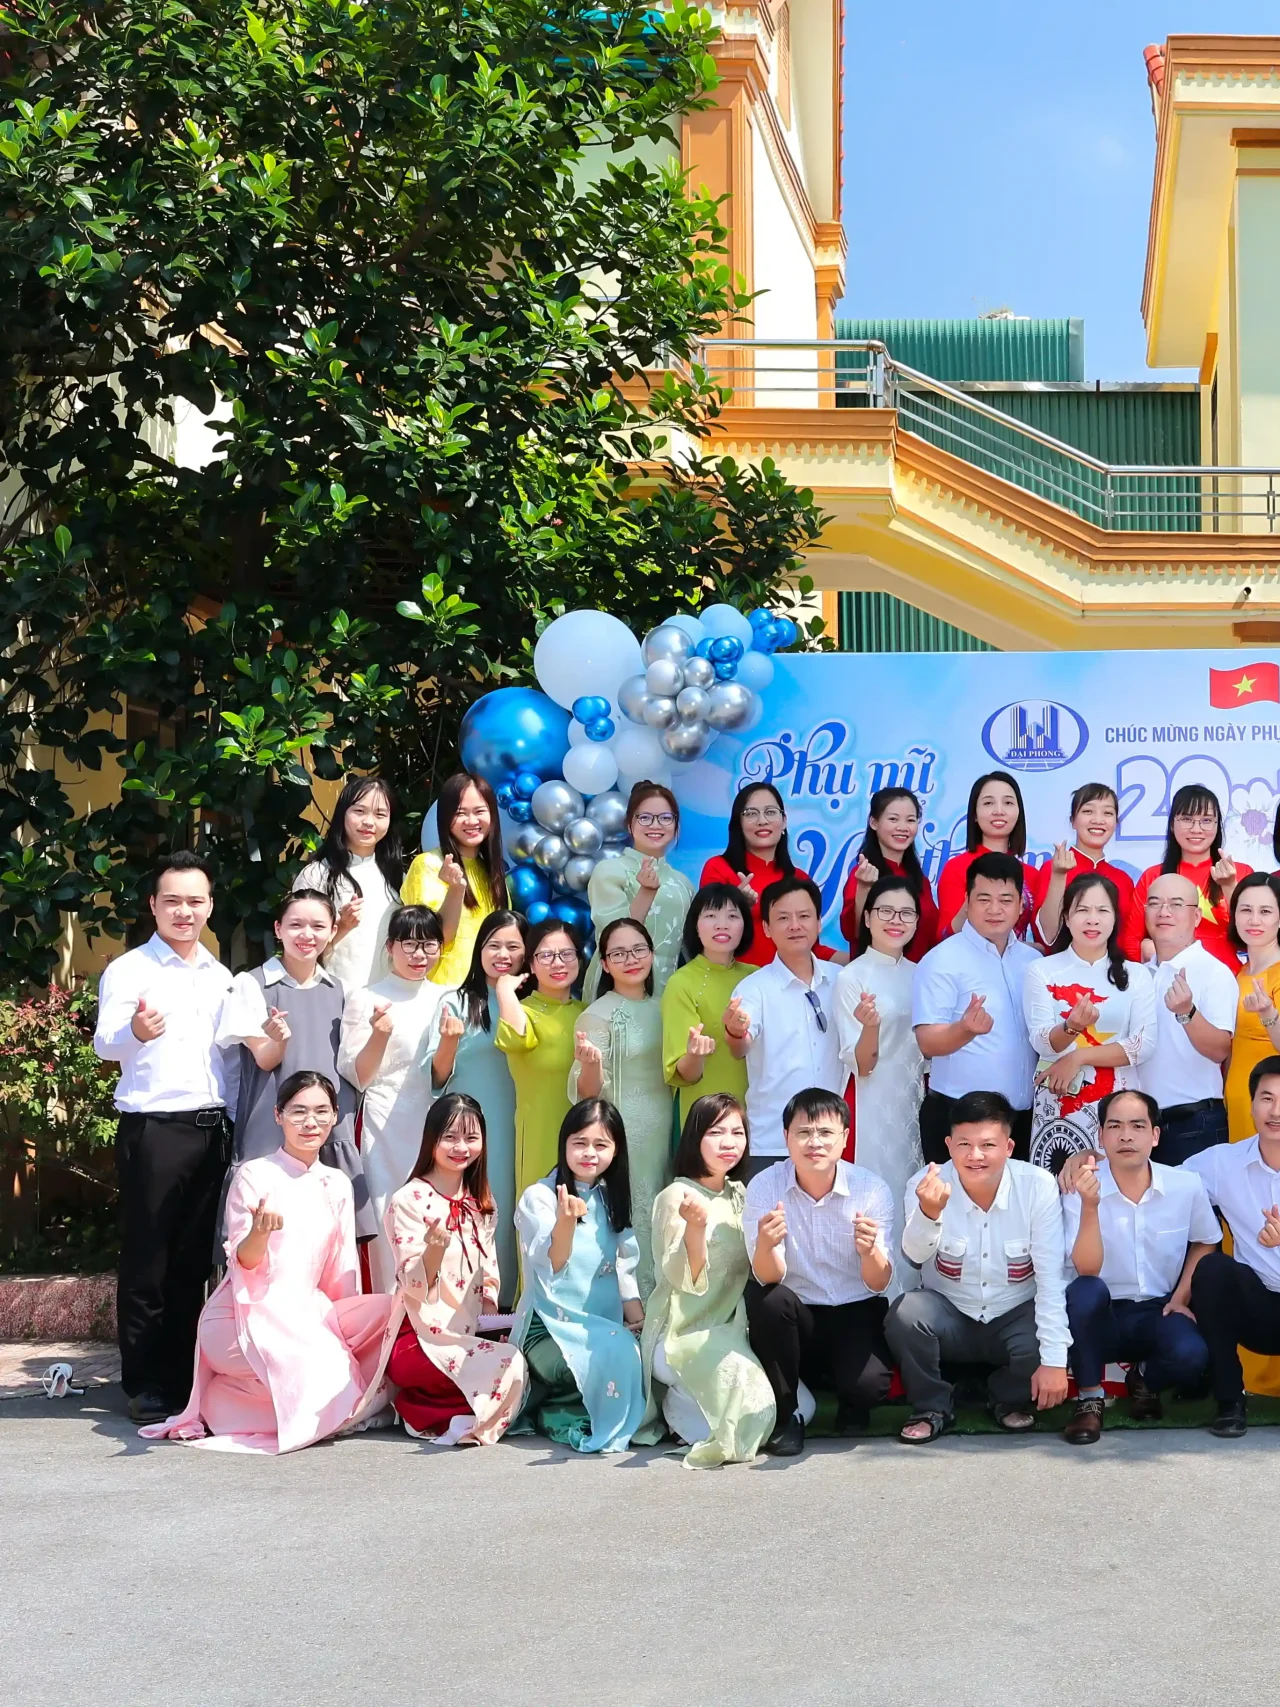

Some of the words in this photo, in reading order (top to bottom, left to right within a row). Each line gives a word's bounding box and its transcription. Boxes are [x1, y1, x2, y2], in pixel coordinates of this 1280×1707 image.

[1105, 723, 1148, 743] CHÚC
[1152, 723, 1199, 743] MỪNG
[1203, 722, 1247, 742] NGÀY
[1029, 750, 1061, 758] PHONG
[738, 721, 856, 810] Phụ
